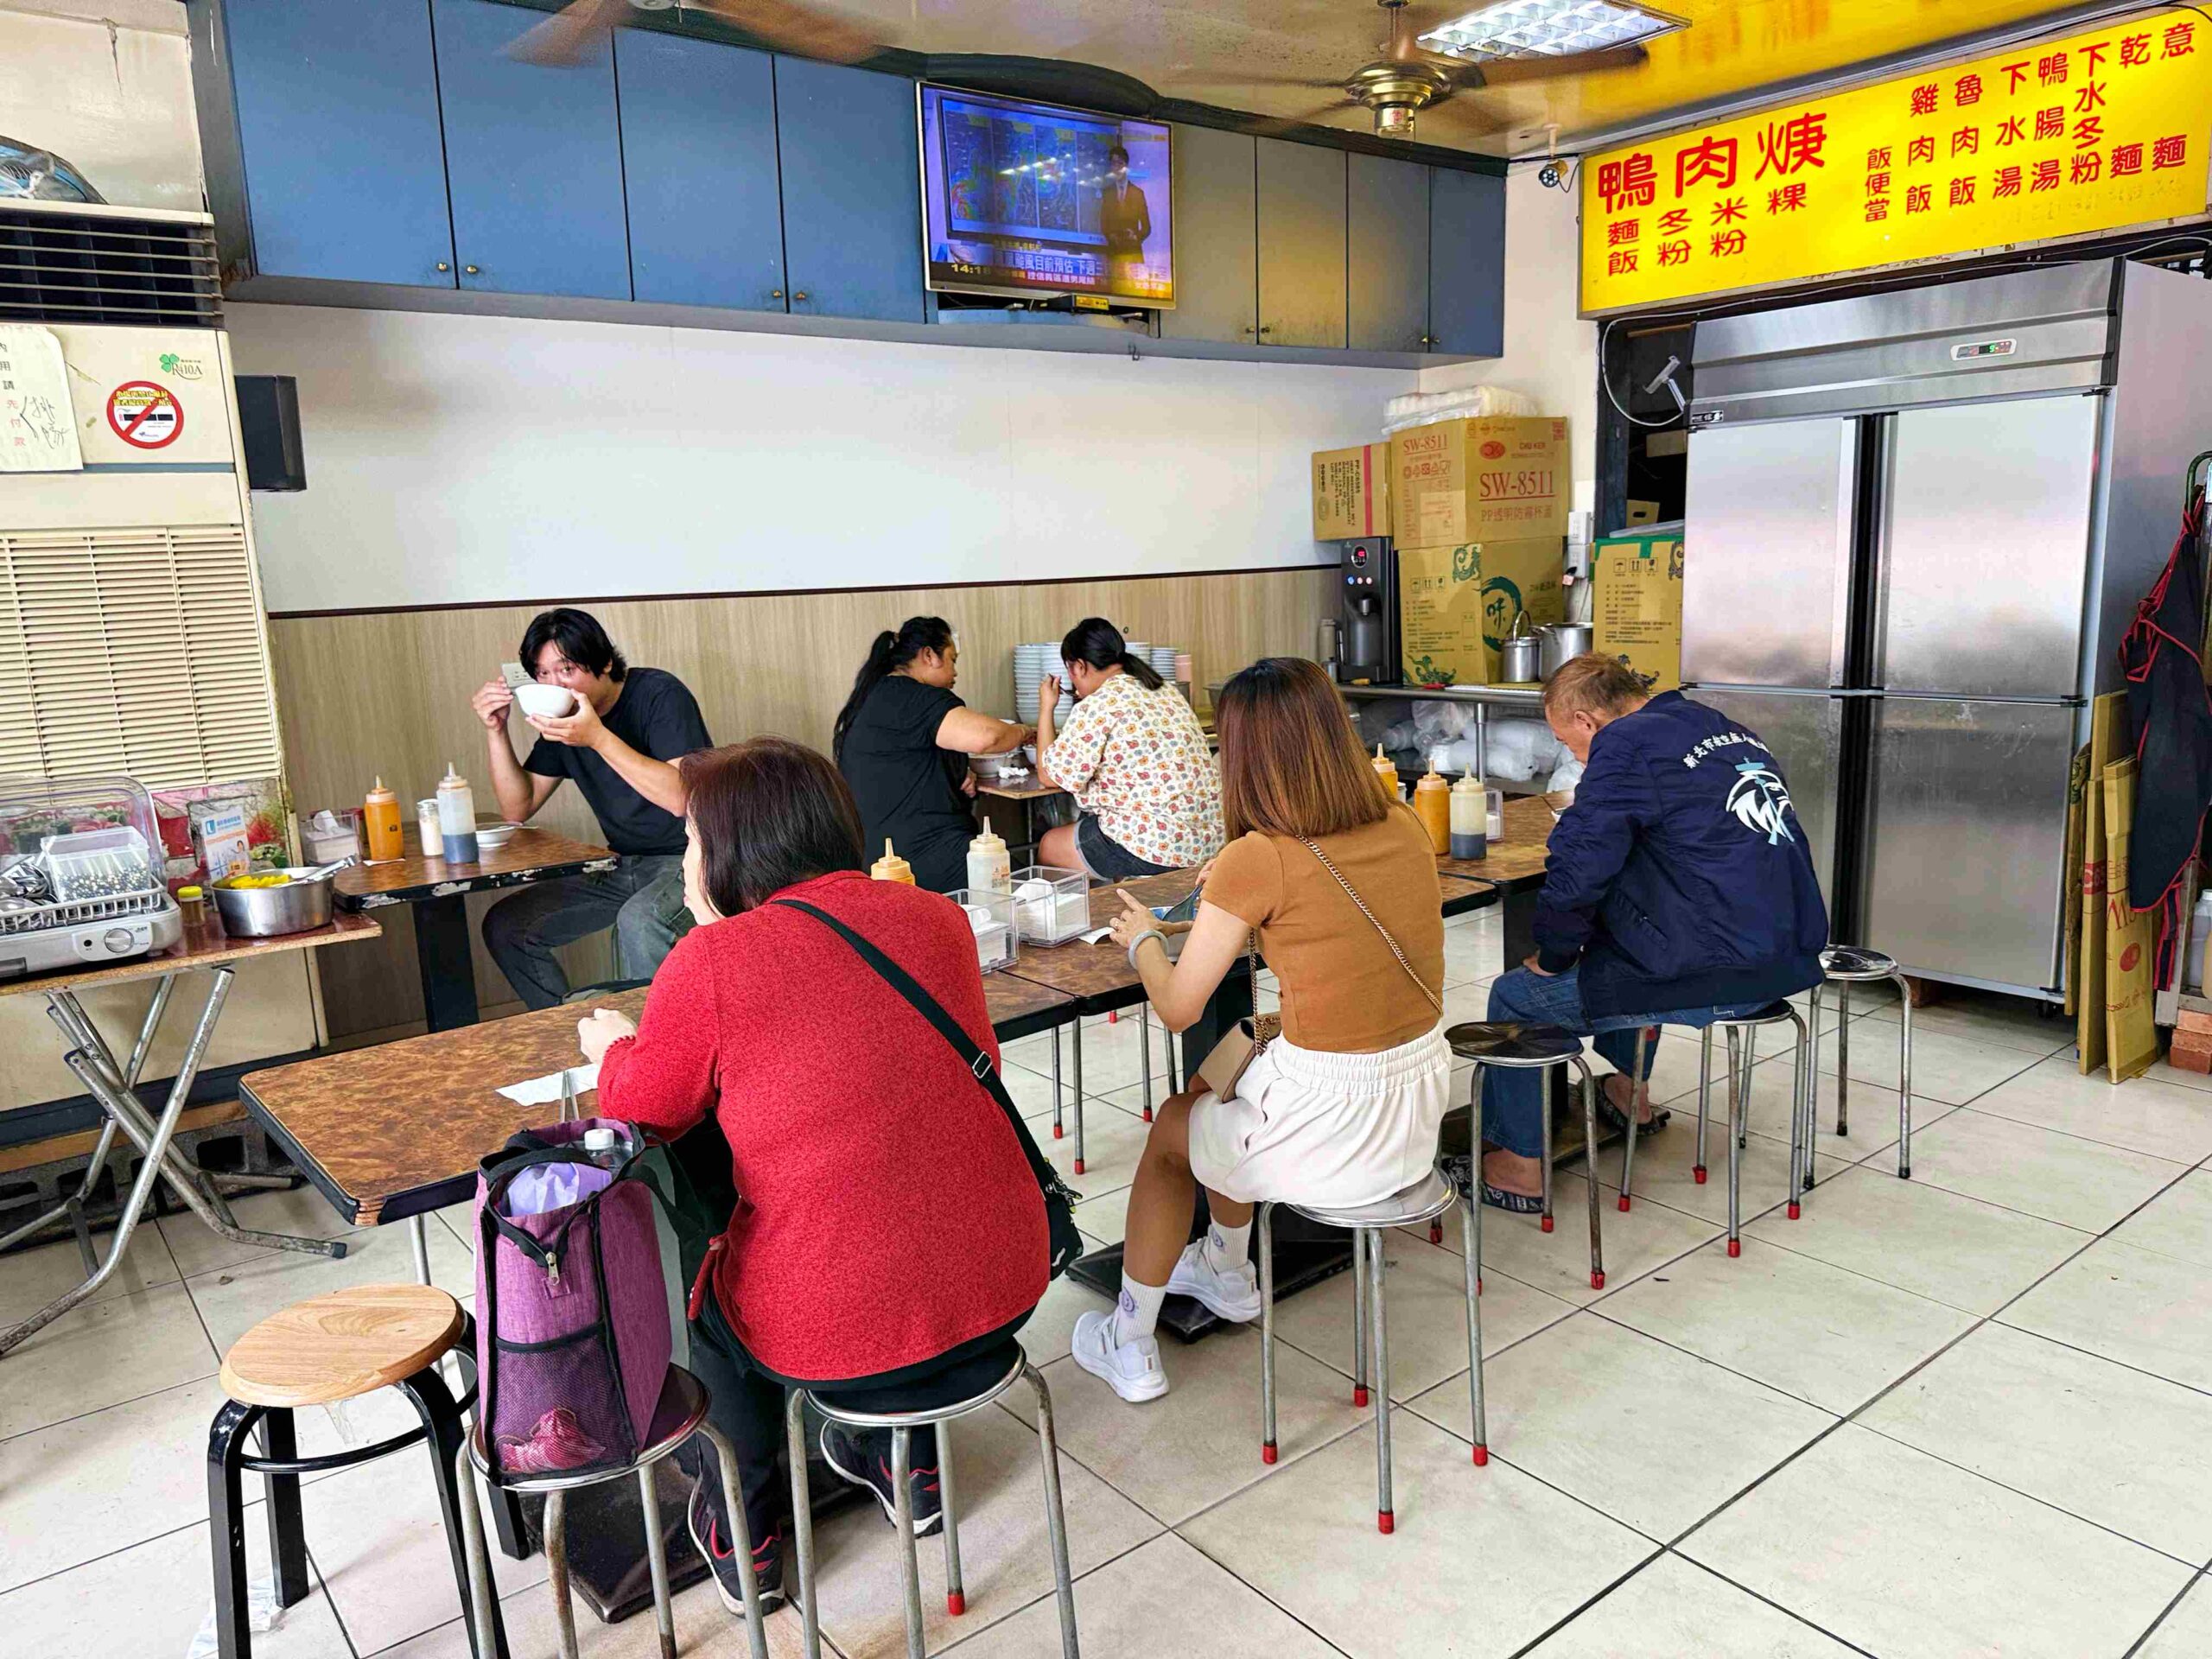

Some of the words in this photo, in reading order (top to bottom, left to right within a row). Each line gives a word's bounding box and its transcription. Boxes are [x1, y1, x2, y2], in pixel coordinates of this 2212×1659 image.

[1949, 73, 1983, 207] 魯肉飯
[1993, 62, 2027, 200] 下水湯
[2030, 53, 2069, 193] 鴨腸湯
[2069, 41, 2110, 185] 下水冬粉
[1906, 83, 1940, 215] 雞肉飯
[1710, 196, 1748, 257] 米粉
[1767, 182, 1807, 215] 粿
[1657, 208, 1693, 267] 冬粉
[172, 362, 203, 378] R410A
[1403, 434, 1447, 454] SW-8511
[1479, 471, 1553, 498] SW-8511
